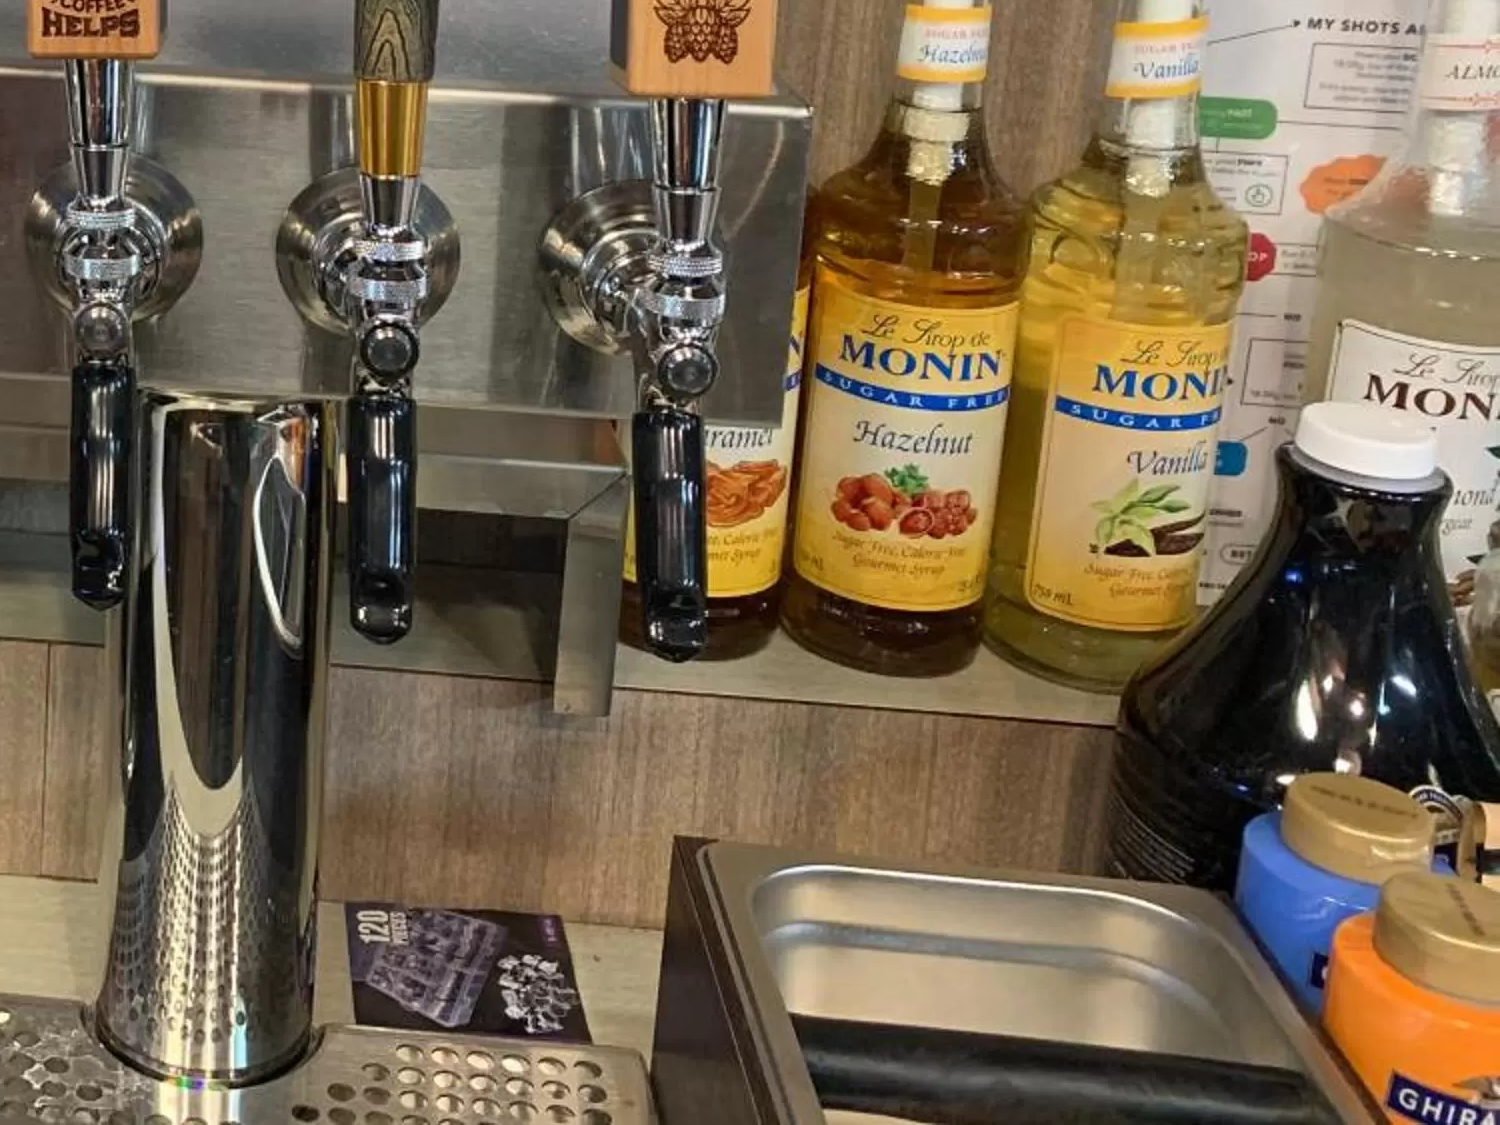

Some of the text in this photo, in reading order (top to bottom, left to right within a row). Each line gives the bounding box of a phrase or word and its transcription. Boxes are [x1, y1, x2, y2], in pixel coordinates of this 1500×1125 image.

[41, 6, 140, 38] HELPS
[1307, 18, 1334, 31] MY
[1341, 20, 1400, 35] SHOTS
[861, 314, 993, 353] Le Sirop de
[839, 333, 1003, 382] MONIN
[1119, 340, 1164, 365] Le
[1394, 351, 1441, 378] Le
[824, 372, 924, 408] SUGAR
[1071, 403, 1182, 429] SUGAR
[852, 420, 973, 456] Hazelnut
[1126, 439, 1209, 476] Vanilla
[356, 910, 390, 944] 120
